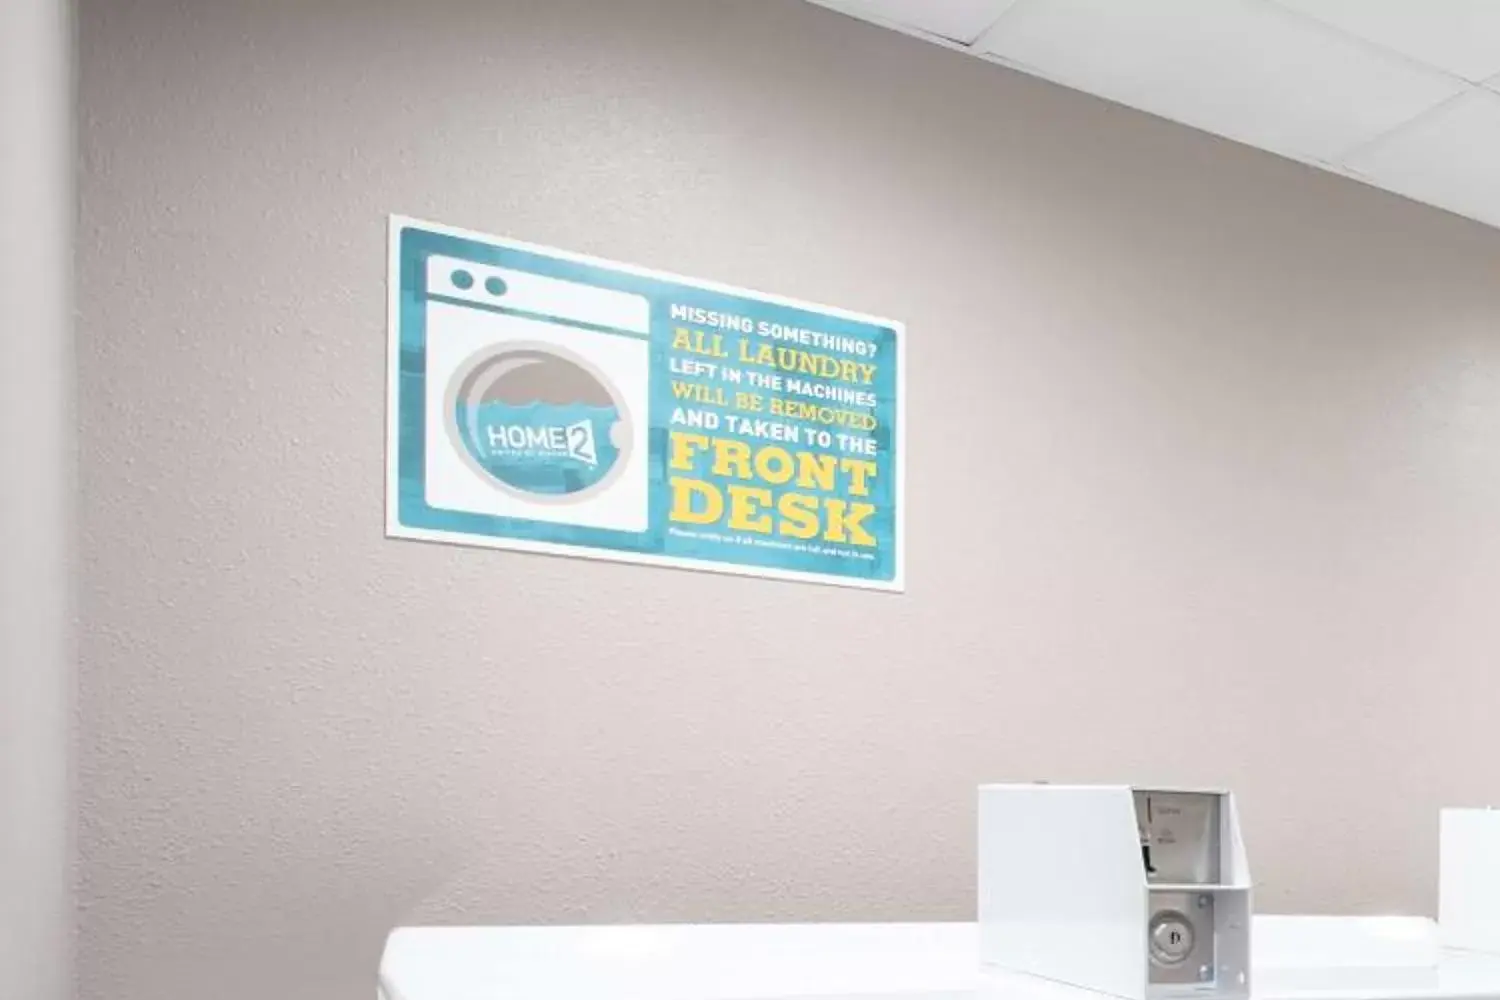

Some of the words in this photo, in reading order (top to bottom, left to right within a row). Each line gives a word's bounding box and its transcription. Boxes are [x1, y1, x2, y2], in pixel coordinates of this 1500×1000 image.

[671, 303, 753, 333] MISSING
[758, 320, 877, 358] SOMETHING?
[672, 327, 729, 358] ALL
[739, 338, 877, 385] LAUNDRY
[669, 358, 718, 379] LEFT
[721, 367, 741, 384] IN
[747, 371, 783, 391] THE
[786, 379, 877, 407] MACHINES
[671, 380, 728, 406] WILL
[735, 391, 763, 412] BE
[769, 397, 878, 431] REMOVED
[671, 407, 720, 430] AND
[725, 415, 799, 443] TAKEN
[804, 428, 831, 448] TO
[836, 434, 877, 456] THE
[669, 431, 877, 497] FRONT
[669, 476, 877, 546] DESK
